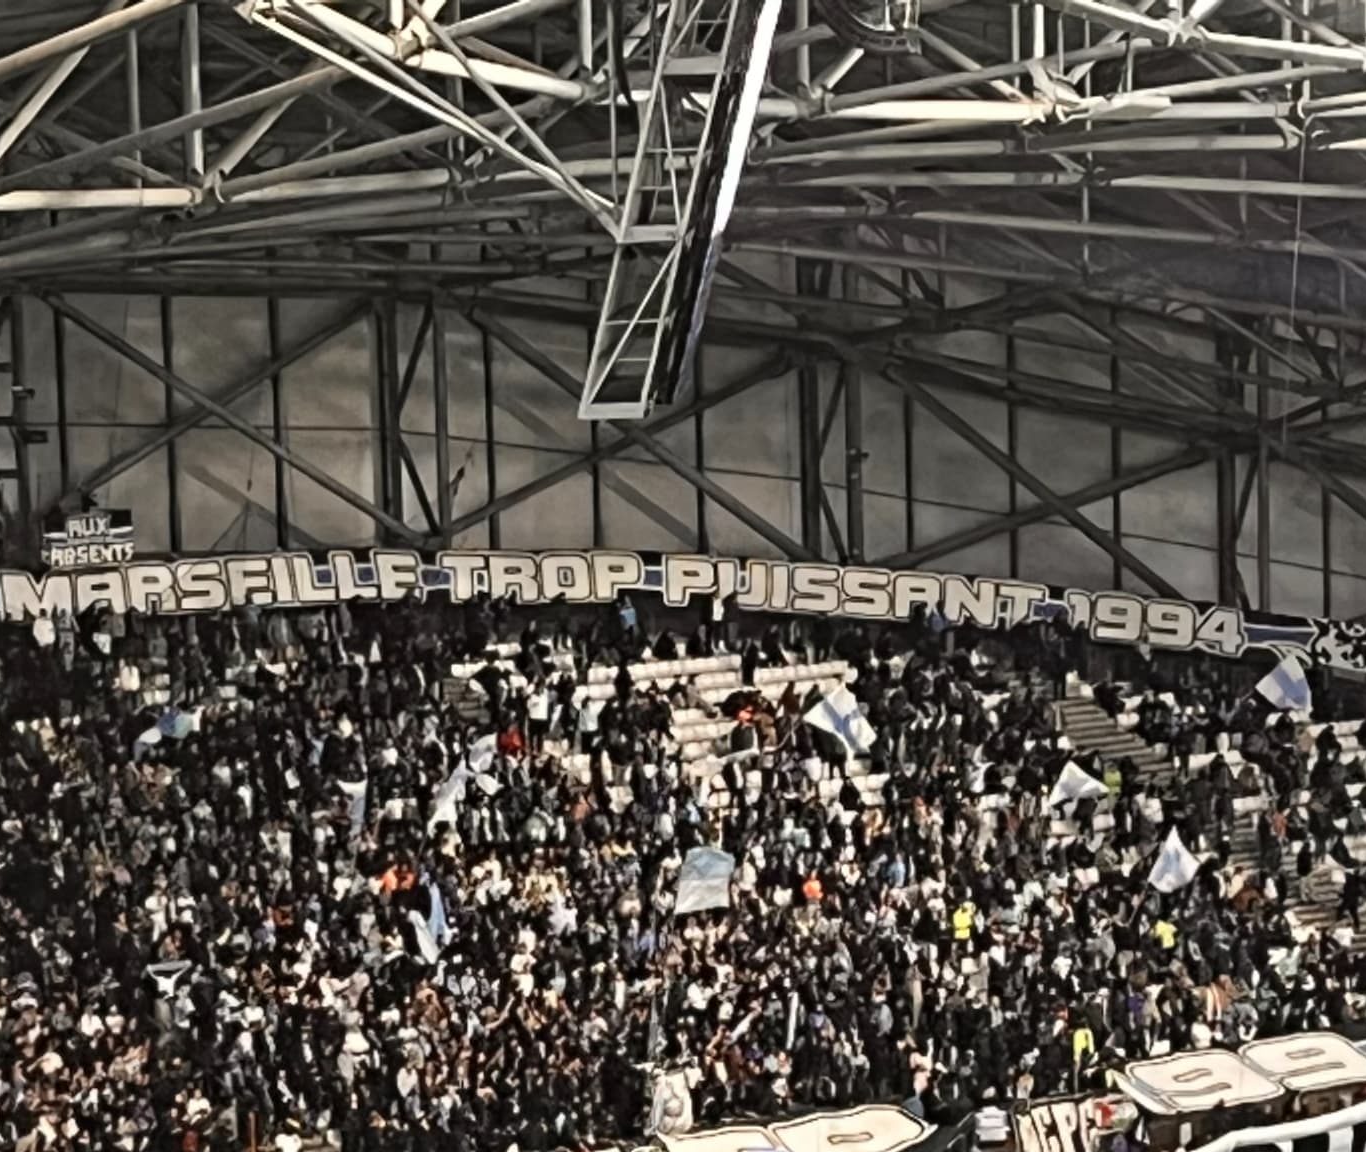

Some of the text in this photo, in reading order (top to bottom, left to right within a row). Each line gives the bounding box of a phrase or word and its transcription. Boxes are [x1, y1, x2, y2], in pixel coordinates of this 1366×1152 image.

[69, 518, 108, 537] AUX
[51, 542, 134, 567] ABSENTS
[0, 550, 1243, 655] MARSEILLE TROP PUISSANT 1994
